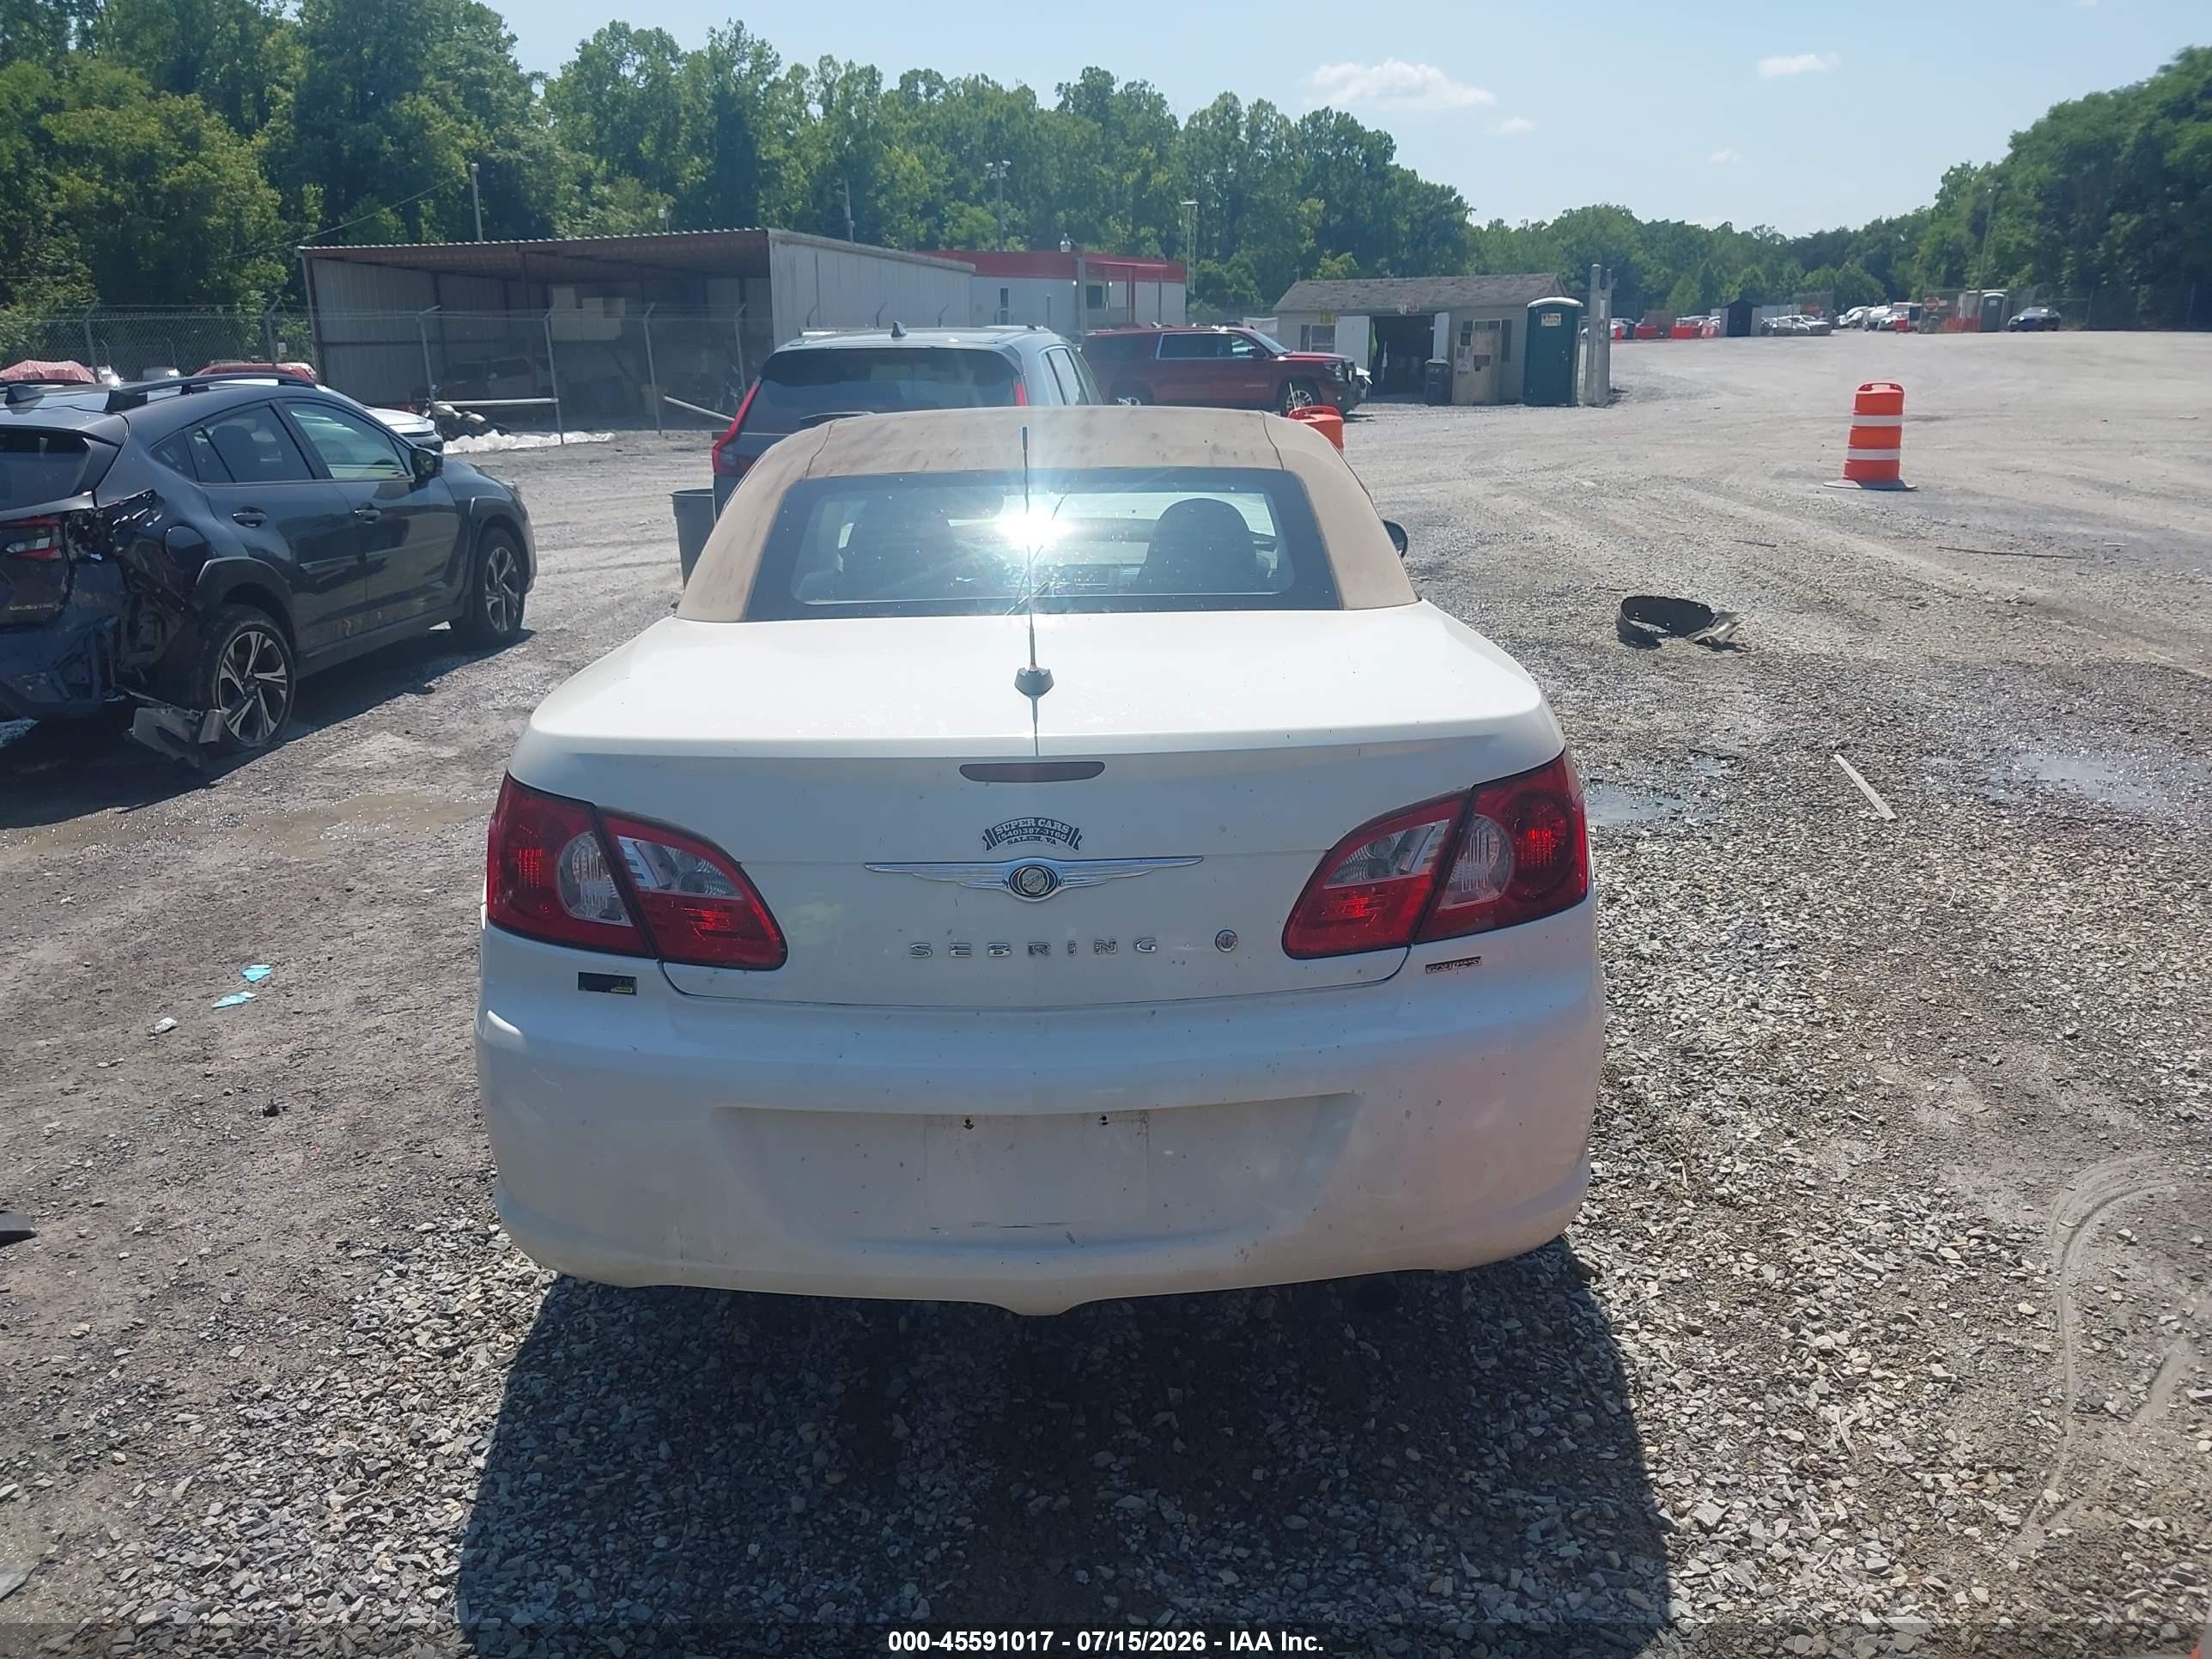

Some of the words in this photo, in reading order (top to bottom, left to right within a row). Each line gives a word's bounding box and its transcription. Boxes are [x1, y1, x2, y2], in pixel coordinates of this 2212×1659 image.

[995, 818, 1036, 835] SUPER
[1038, 819, 1070, 834] CARS
[910, 938, 1157, 958] SEBRING
